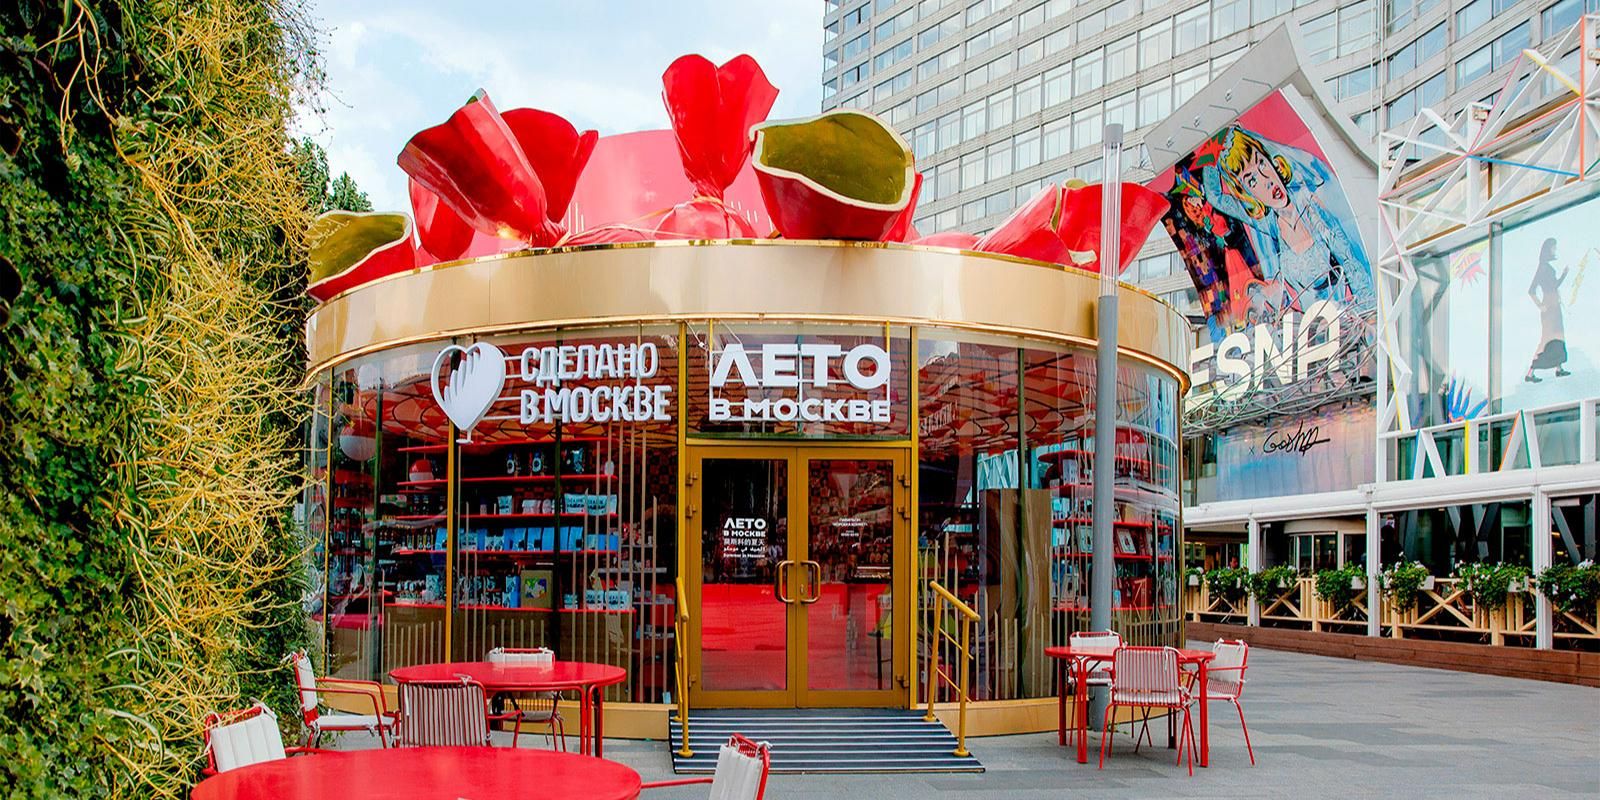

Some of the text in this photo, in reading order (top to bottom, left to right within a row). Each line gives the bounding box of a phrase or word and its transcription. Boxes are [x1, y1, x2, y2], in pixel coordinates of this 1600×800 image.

[519, 342, 659, 386] СДЕЛАНО
[710, 343, 892, 390] ЛЕТО
[519, 385, 673, 425] В МОСКВЕ
[709, 398, 732, 421] В
[743, 398, 891, 423] МОСКВЕ
[723, 517, 767, 530] ЛЕТО
